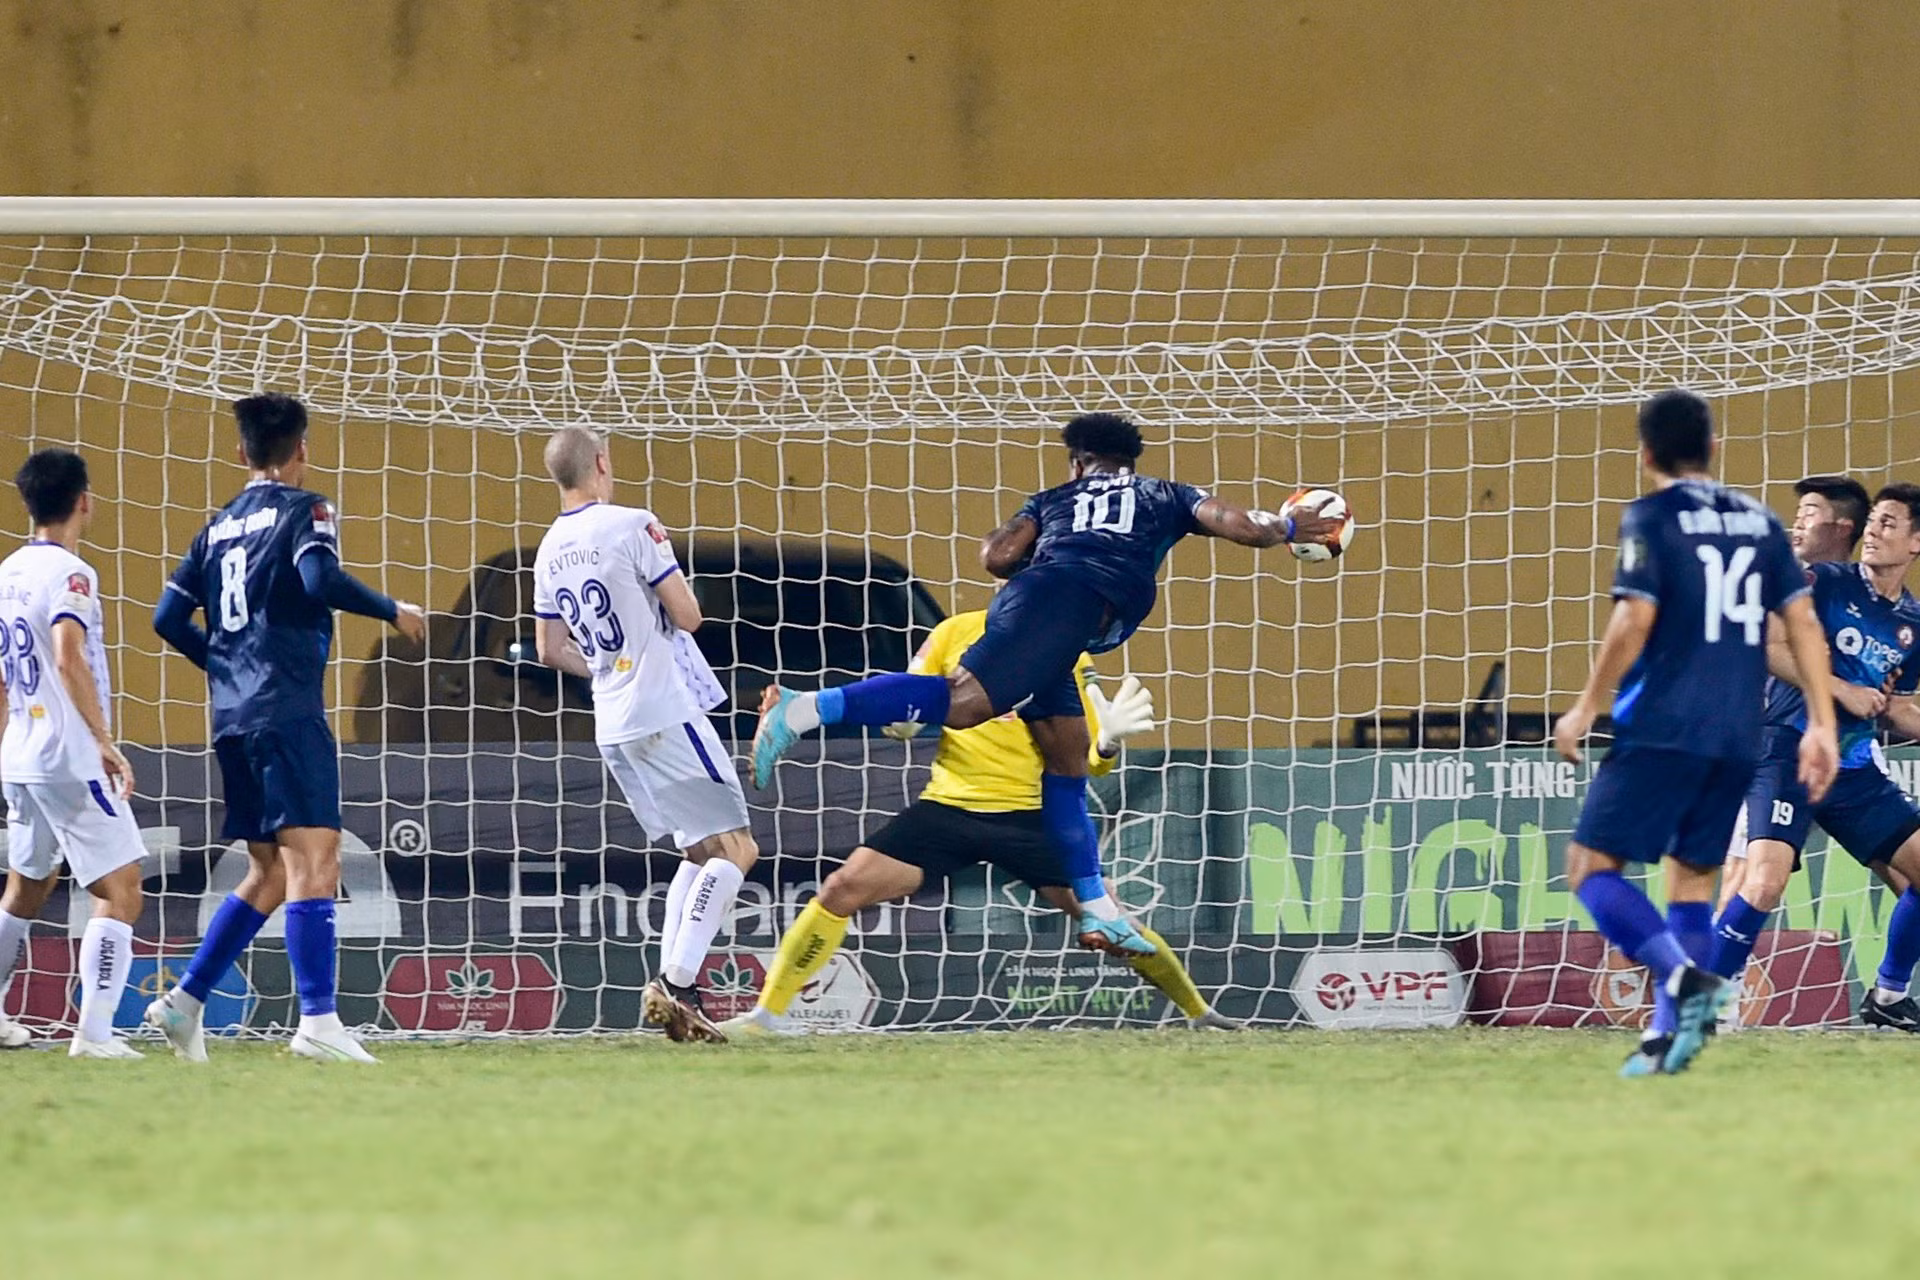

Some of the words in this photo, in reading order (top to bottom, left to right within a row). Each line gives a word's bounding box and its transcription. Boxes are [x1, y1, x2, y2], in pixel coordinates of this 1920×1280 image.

[1072, 486, 1136, 533] 10
[549, 546, 600, 580] EVTOVIĆ
[220, 546, 249, 632] 8
[1696, 544, 1765, 646] 14
[555, 578, 624, 657] 33
[1391, 756, 1476, 800] NƯỚC
[1486, 757, 1576, 799] TĂNG
[1771, 800, 1794, 826] 19
[1249, 805, 1668, 934] NIGH
[688, 872, 718, 922] JOGARBOLA
[97, 936, 115, 991] JOGARBOLA
[1361, 971, 1448, 1001] VPF
